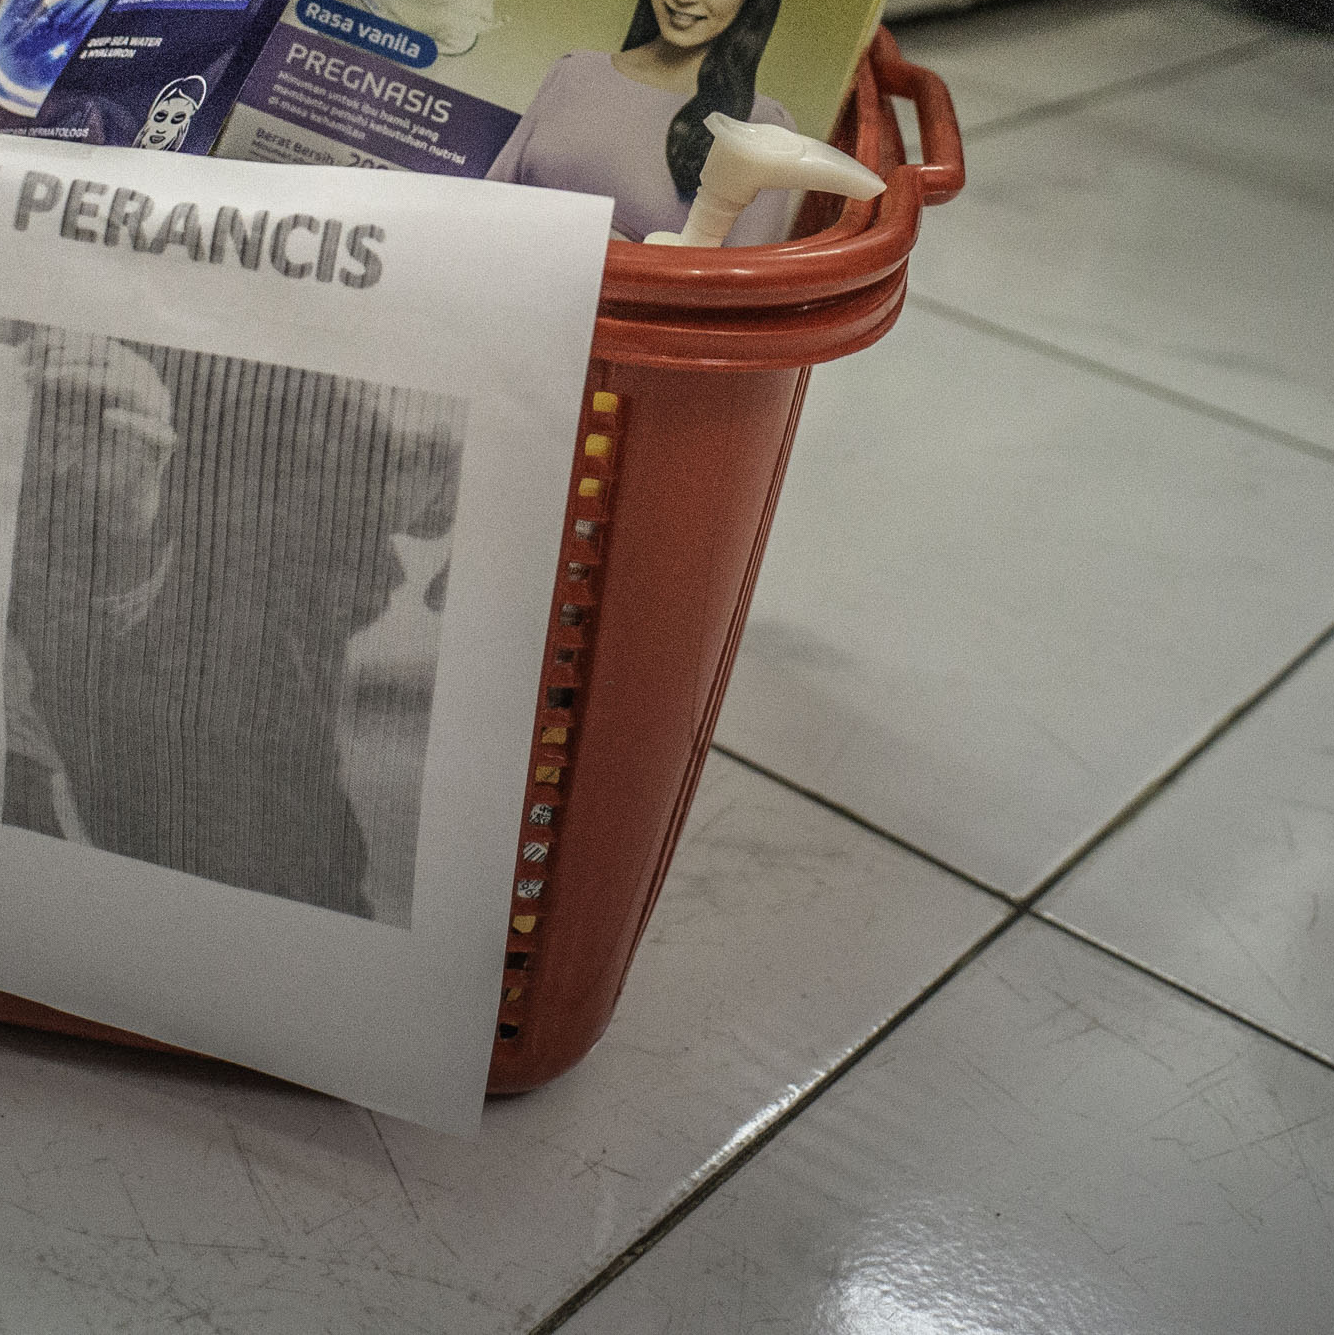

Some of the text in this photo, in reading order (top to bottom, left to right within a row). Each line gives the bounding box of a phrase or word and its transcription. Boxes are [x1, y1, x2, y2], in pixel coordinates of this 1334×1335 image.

[112, 36, 129, 46] SEA
[129, 36, 163, 47] WATER
[305, 2, 421, 58] Rasa vanila
[285, 43, 452, 123] PREGNASIS
[256, 127, 292, 149] Berat
[310, 110, 366, 140] kehamilan
[328, 90, 360, 111] untuk
[381, 108, 412, 130] hamil
[412, 122, 439, 144] yang
[369, 119, 428, 151] kebutuhan
[428, 143, 466, 165] nutrisi
[14, 170, 386, 289] PERANCIS
